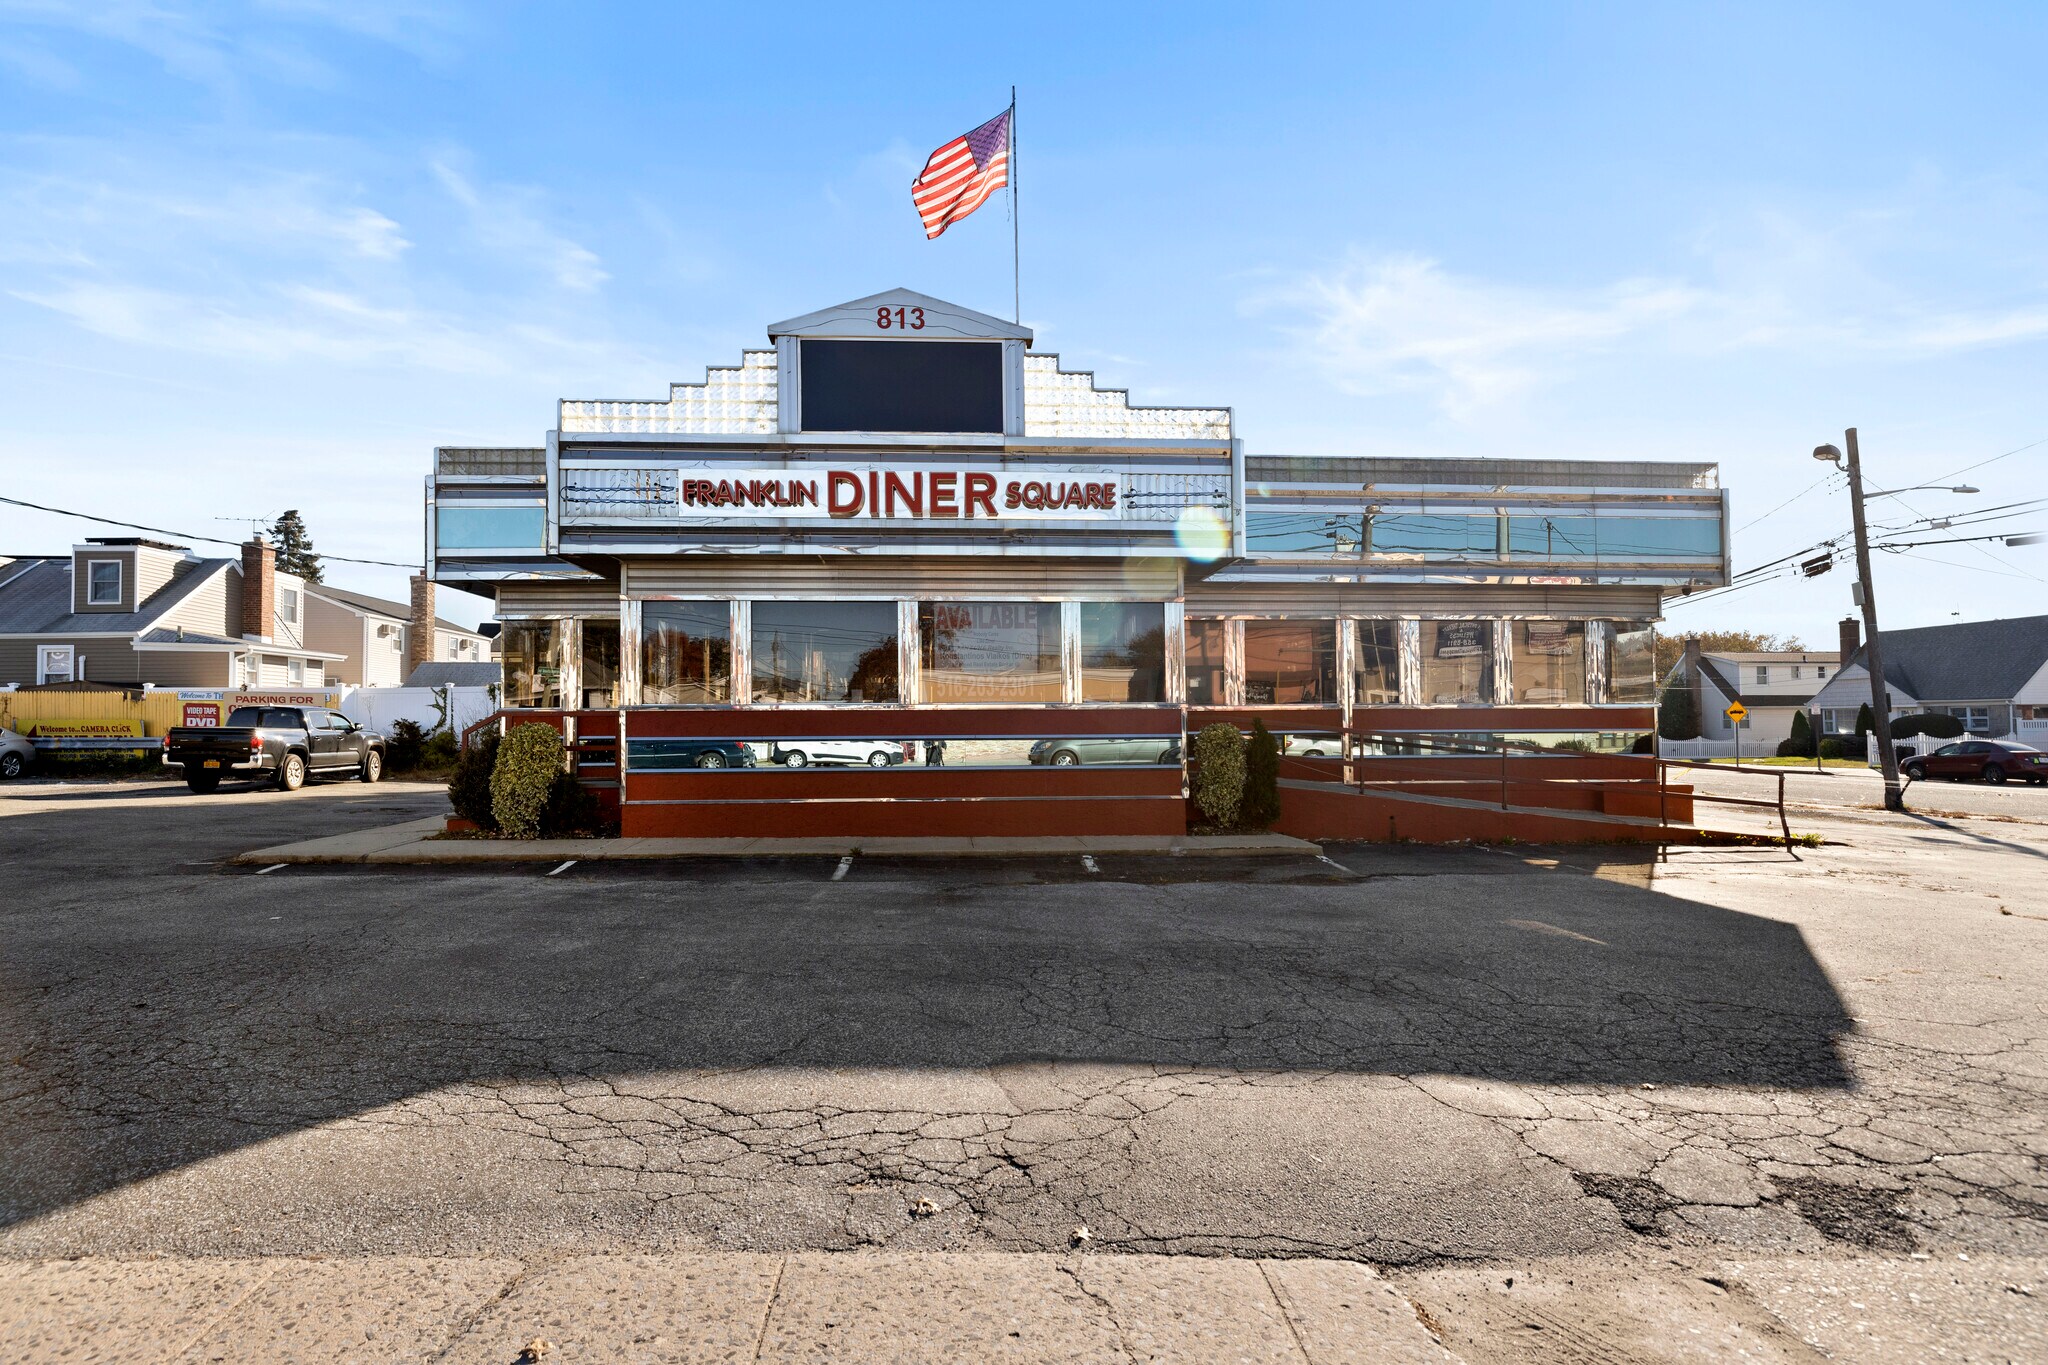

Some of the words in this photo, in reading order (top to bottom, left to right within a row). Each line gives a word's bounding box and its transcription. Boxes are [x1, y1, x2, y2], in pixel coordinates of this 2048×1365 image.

[877, 307, 925, 330] 813
[682, 479, 819, 507] FRANKLIN
[827, 470, 999, 519] DINER
[1004, 481, 1117, 511] SQUARE
[936, 605, 1037, 630] AVAILABLE
[236, 695, 286, 704] PARKING
[289, 696, 313, 704] FOR
[187, 706, 203, 714] VIDEO
[187, 717, 216, 727] DVD
[40, 725, 68, 733] Welcome
[81, 725, 110, 733] CAMERA
